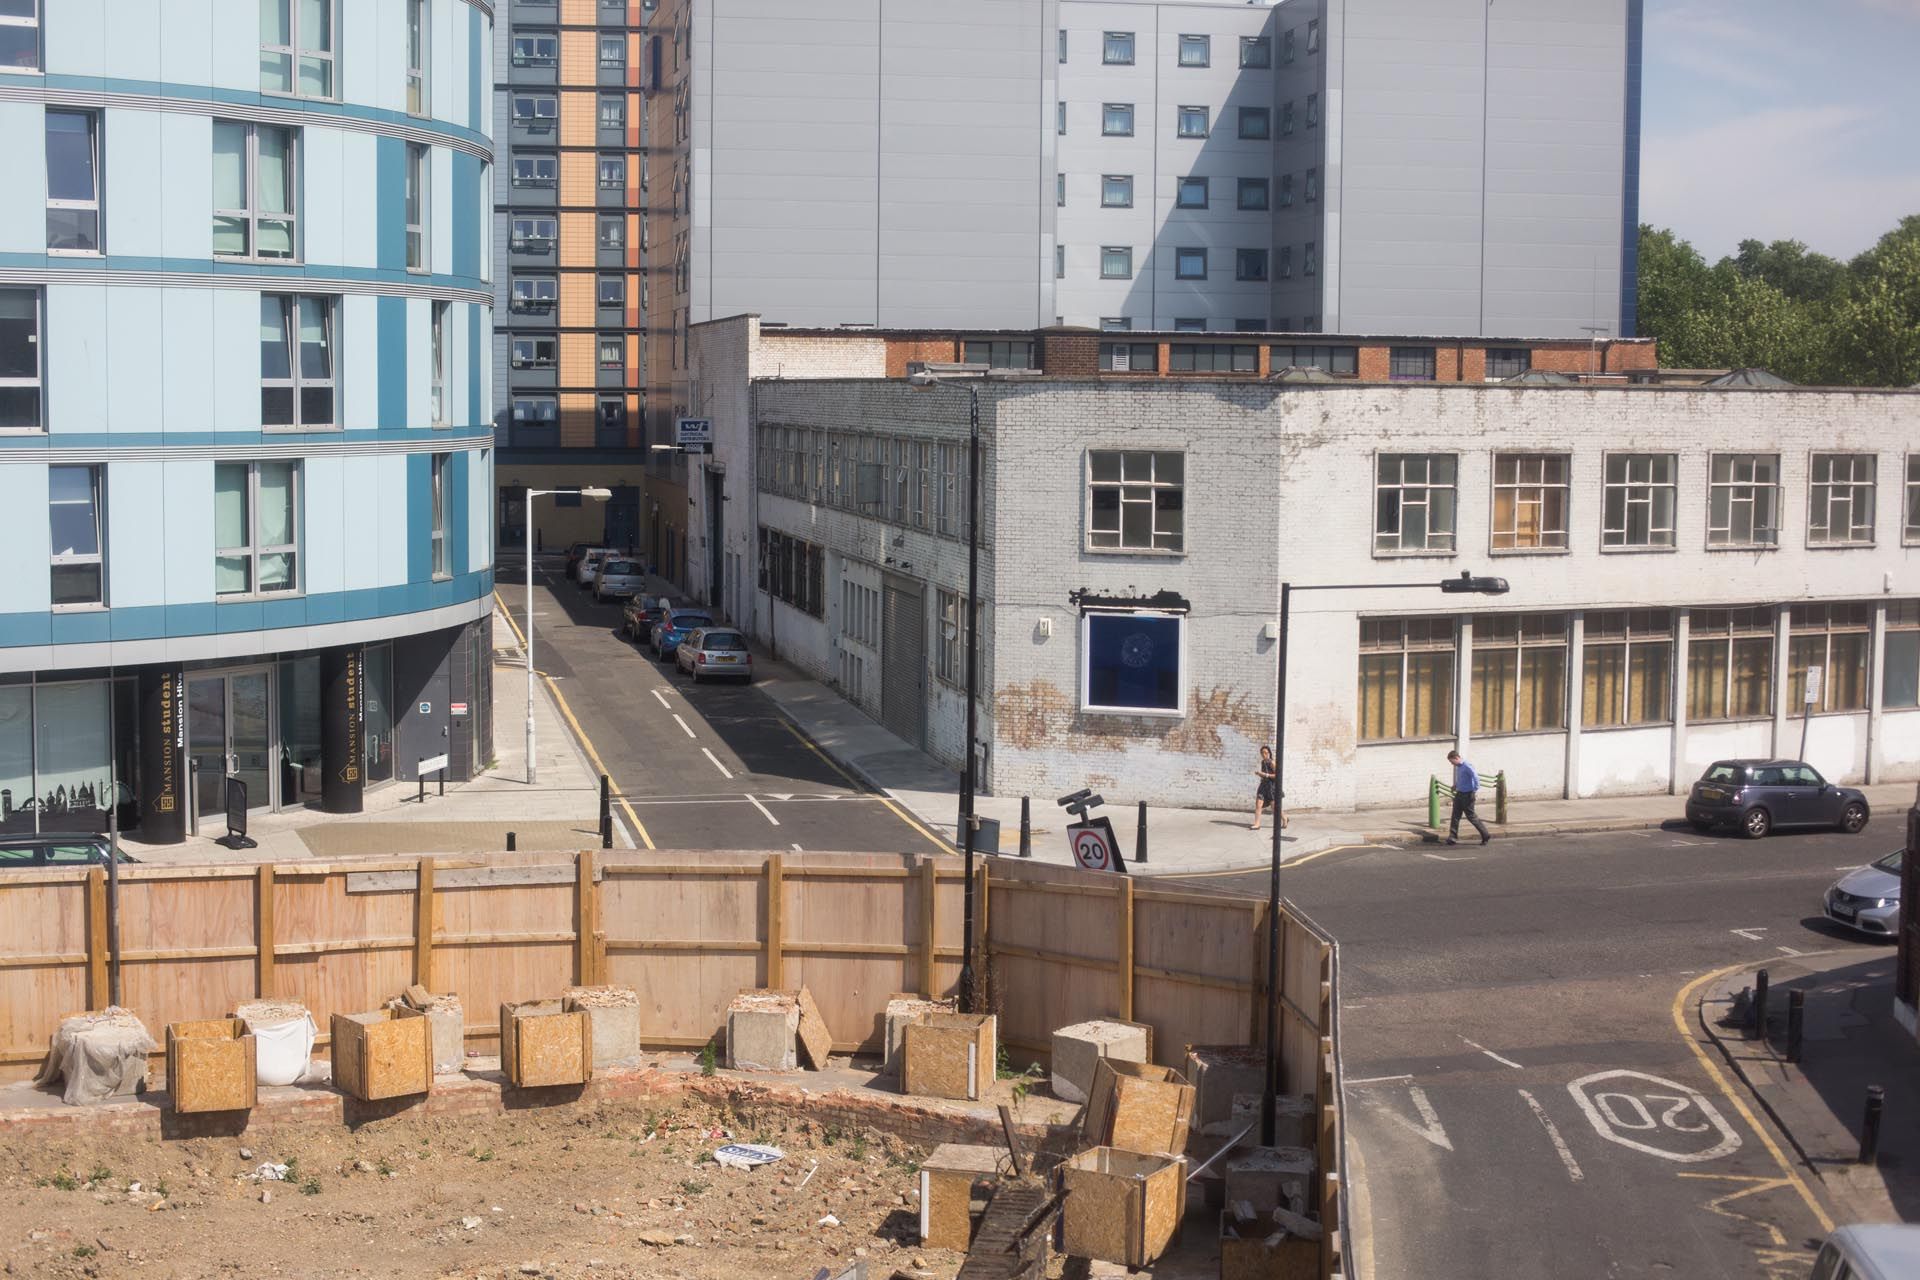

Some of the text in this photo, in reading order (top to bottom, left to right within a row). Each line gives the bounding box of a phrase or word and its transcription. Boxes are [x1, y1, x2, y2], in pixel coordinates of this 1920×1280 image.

[161, 672, 173, 793] MANSION student
[346, 651, 356, 764] MANSION student
[1080, 843, 1104, 860] 20
[1593, 1092, 1710, 1133] 20
